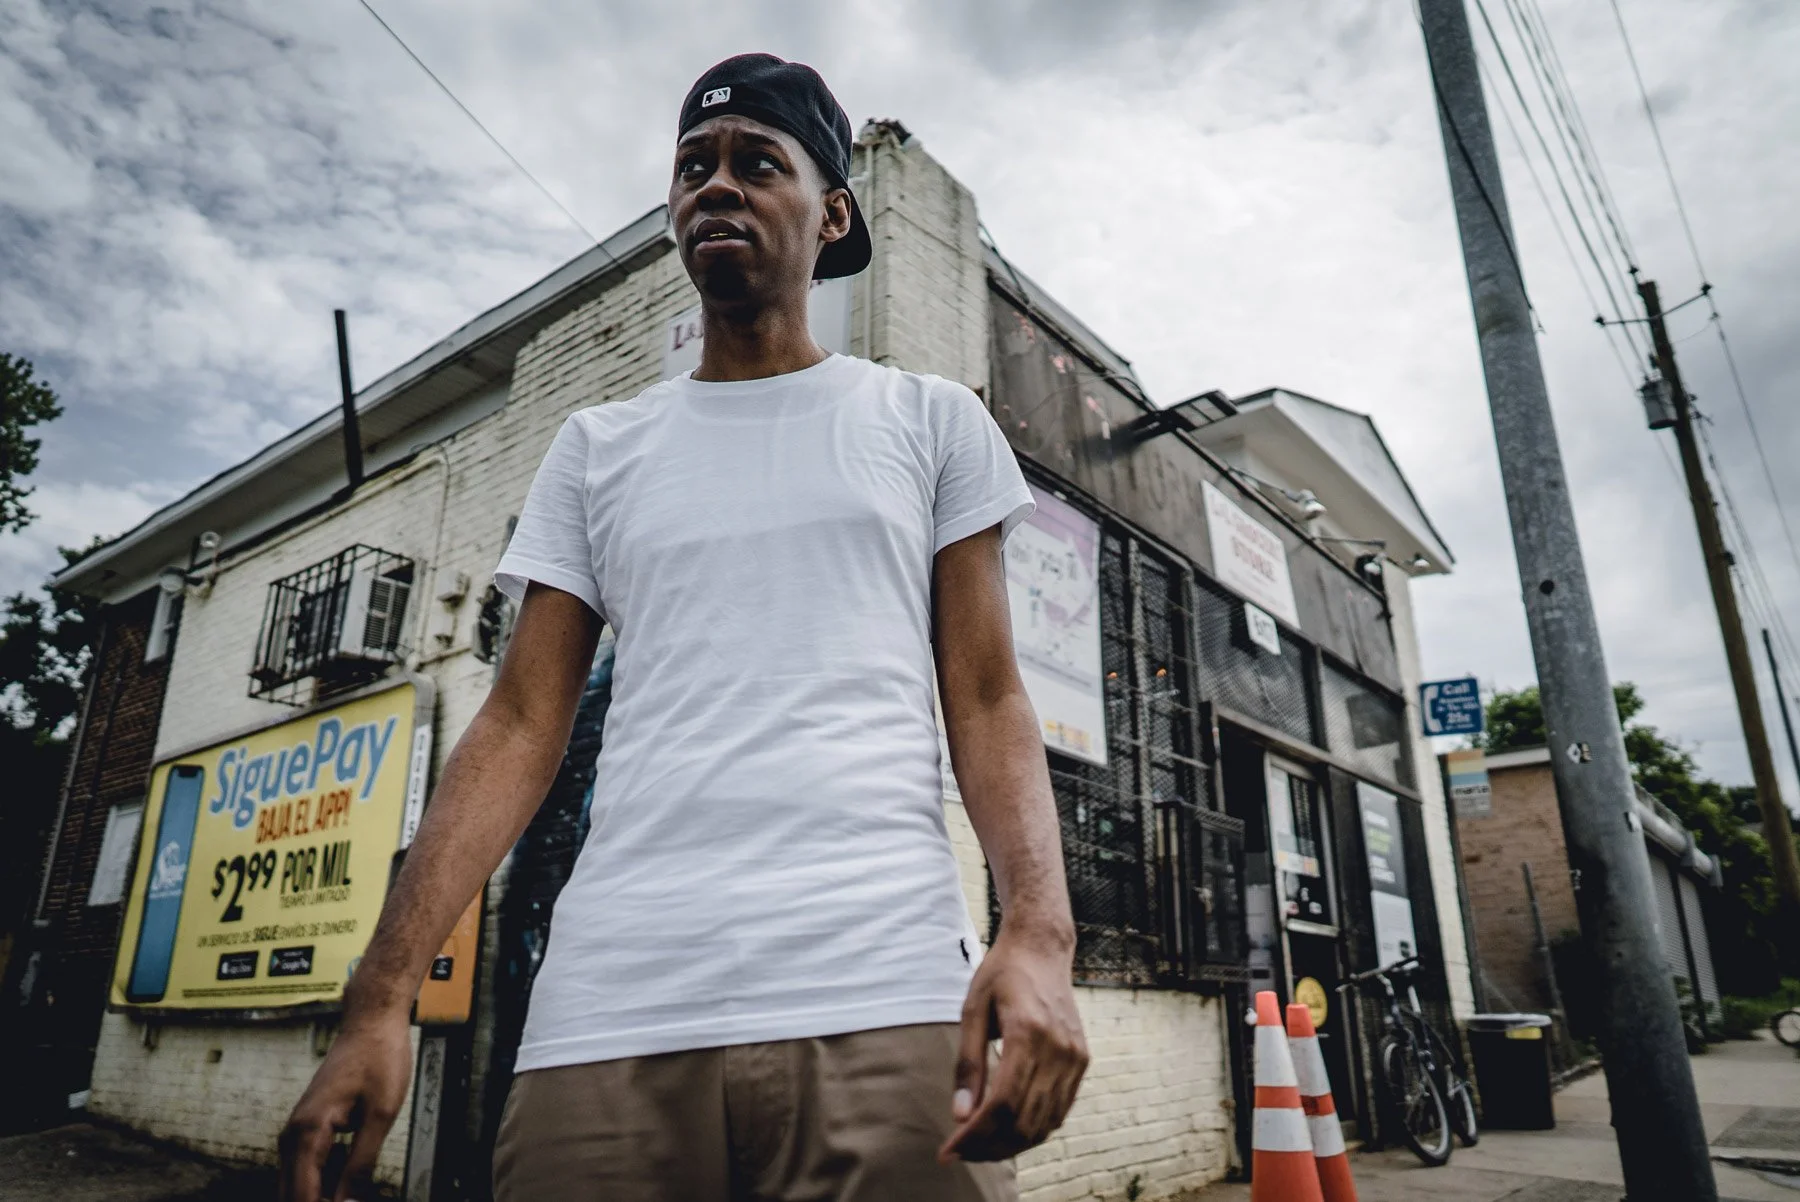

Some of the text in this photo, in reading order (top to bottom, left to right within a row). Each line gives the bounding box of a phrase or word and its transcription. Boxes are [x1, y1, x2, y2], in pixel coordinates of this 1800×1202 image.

[1442, 682, 1470, 695] Call
[210, 716, 398, 829] SiguePay
[255, 788, 352, 844] BAJA EL APP!
[280, 846, 317, 894] POR
[318, 840, 351, 888] MIL
[253, 925, 279, 942] SIGUE
